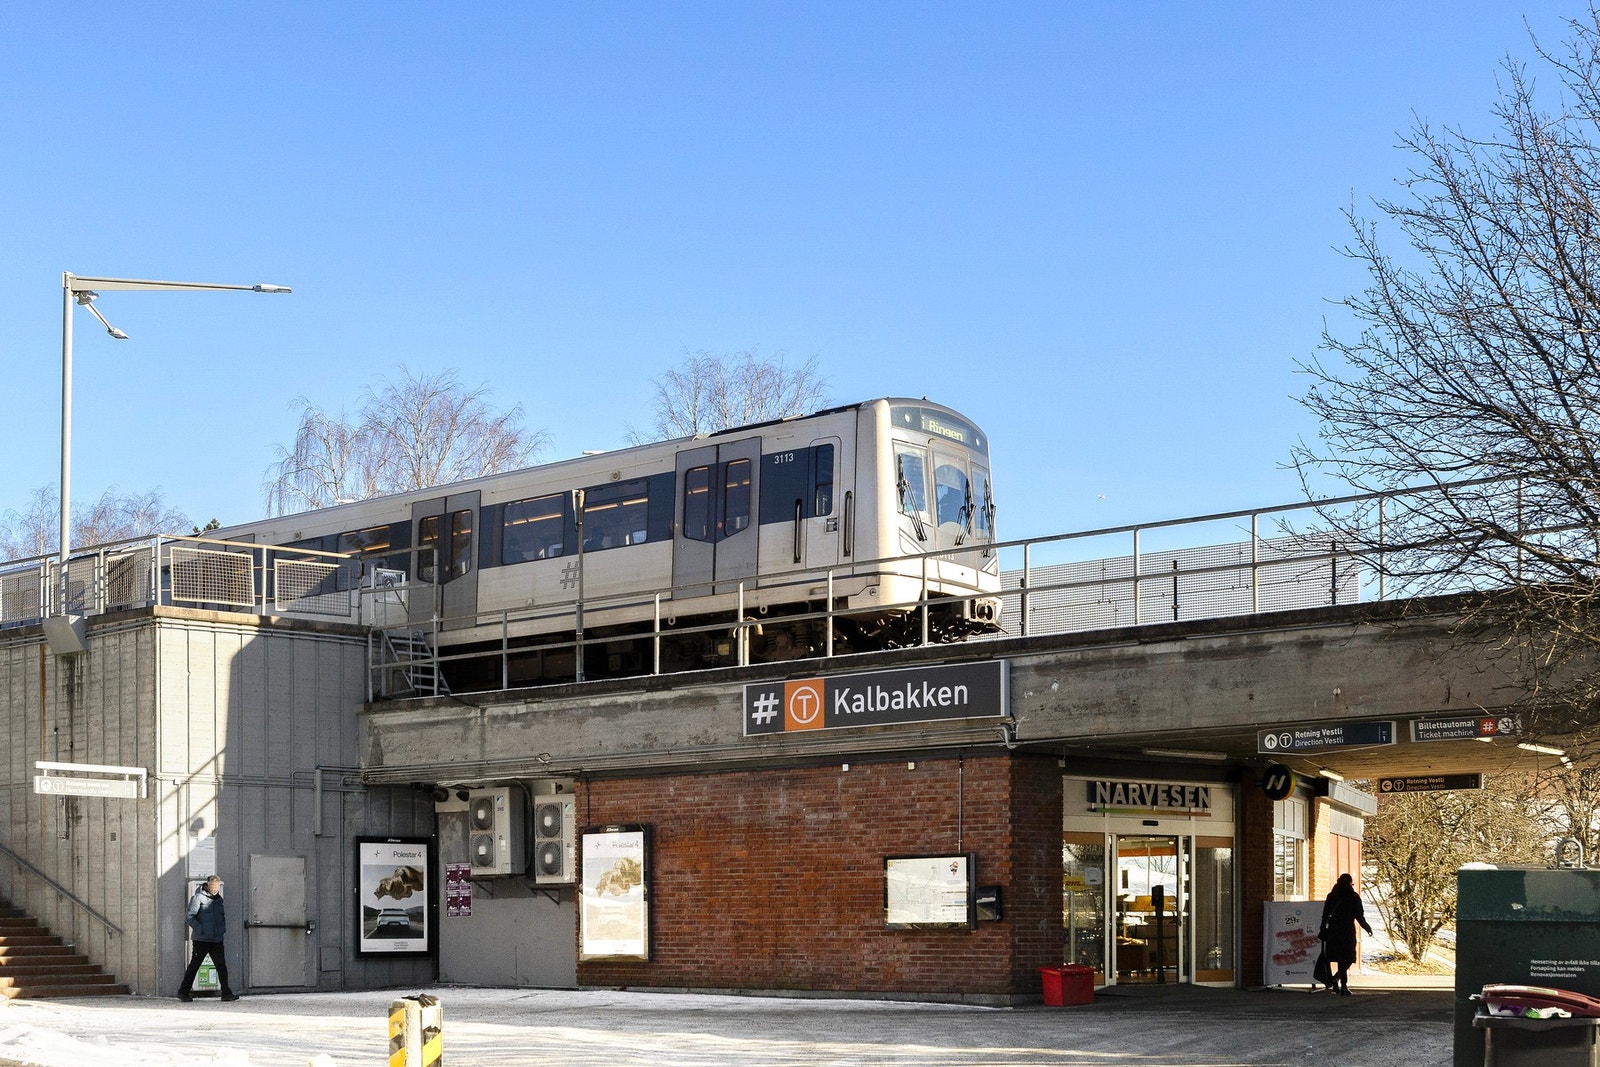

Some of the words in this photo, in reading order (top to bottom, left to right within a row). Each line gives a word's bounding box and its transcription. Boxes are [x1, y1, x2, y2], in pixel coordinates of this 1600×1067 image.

[929, 420, 963, 441] Ringen
[774, 453, 794, 464] 3113
[834, 681, 968, 715] Kalbakken
[1418, 720, 1475, 730] Billettautomat
[1295, 730, 1320, 739] Retning
[1321, 727, 1343, 736] Vestli
[1419, 731, 1441, 739] Ticket
[1442, 729, 1474, 737] machine
[1295, 739, 1323, 747] Direction
[1324, 736, 1344, 744] Vestli
[1096, 781, 1210, 808] NARVESEN
